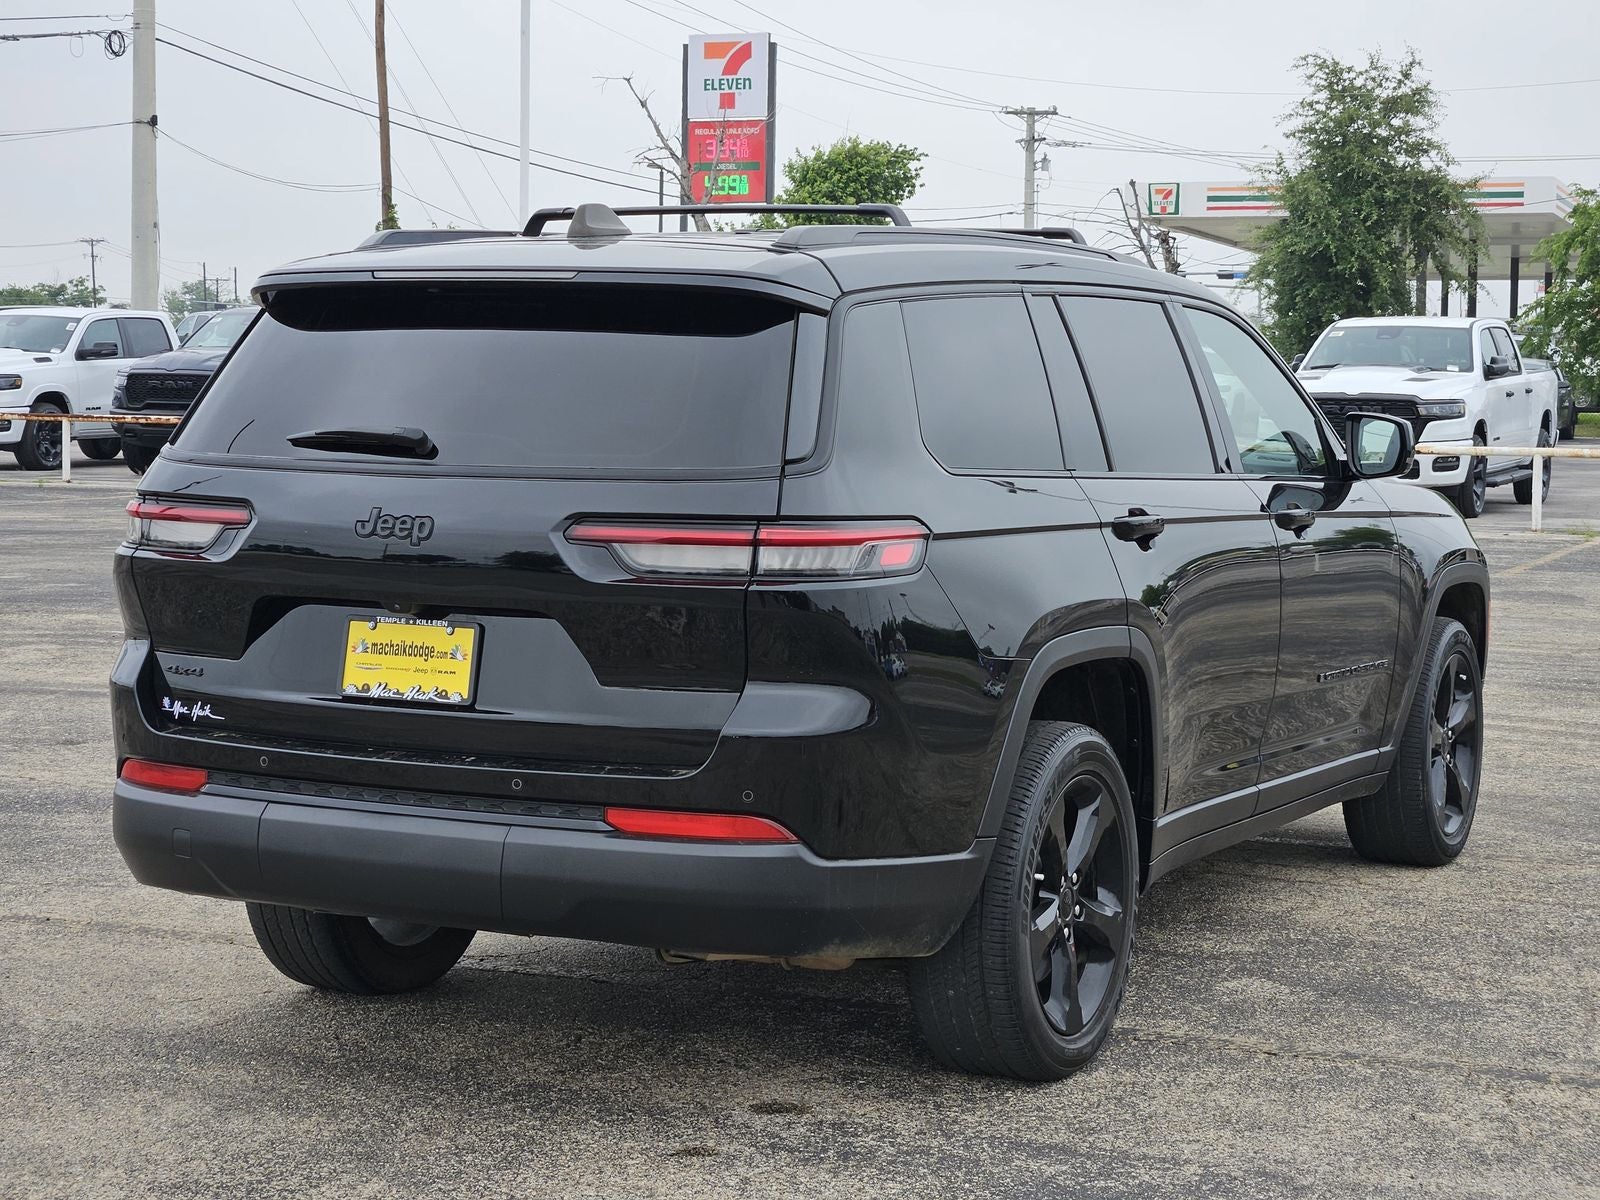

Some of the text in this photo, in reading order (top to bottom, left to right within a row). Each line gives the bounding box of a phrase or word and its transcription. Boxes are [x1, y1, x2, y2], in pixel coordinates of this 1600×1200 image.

[703, 41, 752, 109] 7
[355, 506, 434, 547] Jeep
[376, 616, 449, 628] TEMPLE KILLEEN
[370, 639, 449, 662] machaikdodge.com
[413, 666, 429, 675] Jeep
[366, 682, 450, 701] Mac Haik
[170, 700, 191, 720] Mac
